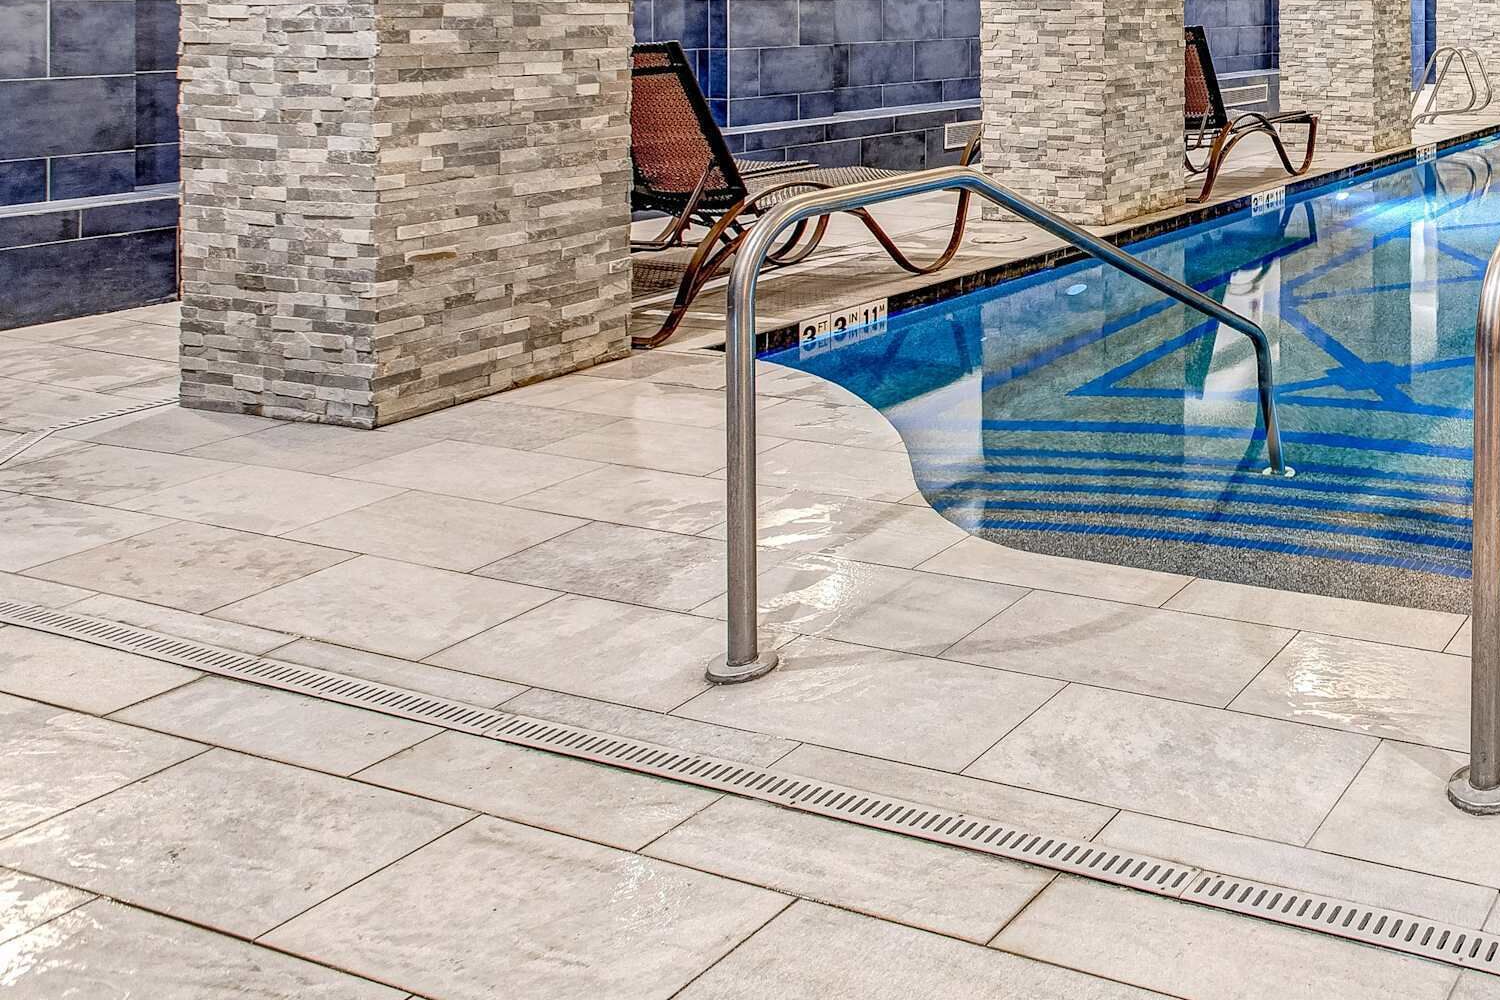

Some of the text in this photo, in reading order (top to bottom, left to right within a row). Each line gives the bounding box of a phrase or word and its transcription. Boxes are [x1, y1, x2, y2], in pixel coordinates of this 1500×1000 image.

[818, 320, 828, 332] FT
[848, 312, 858, 324] IN
[879, 304, 885, 313] M
